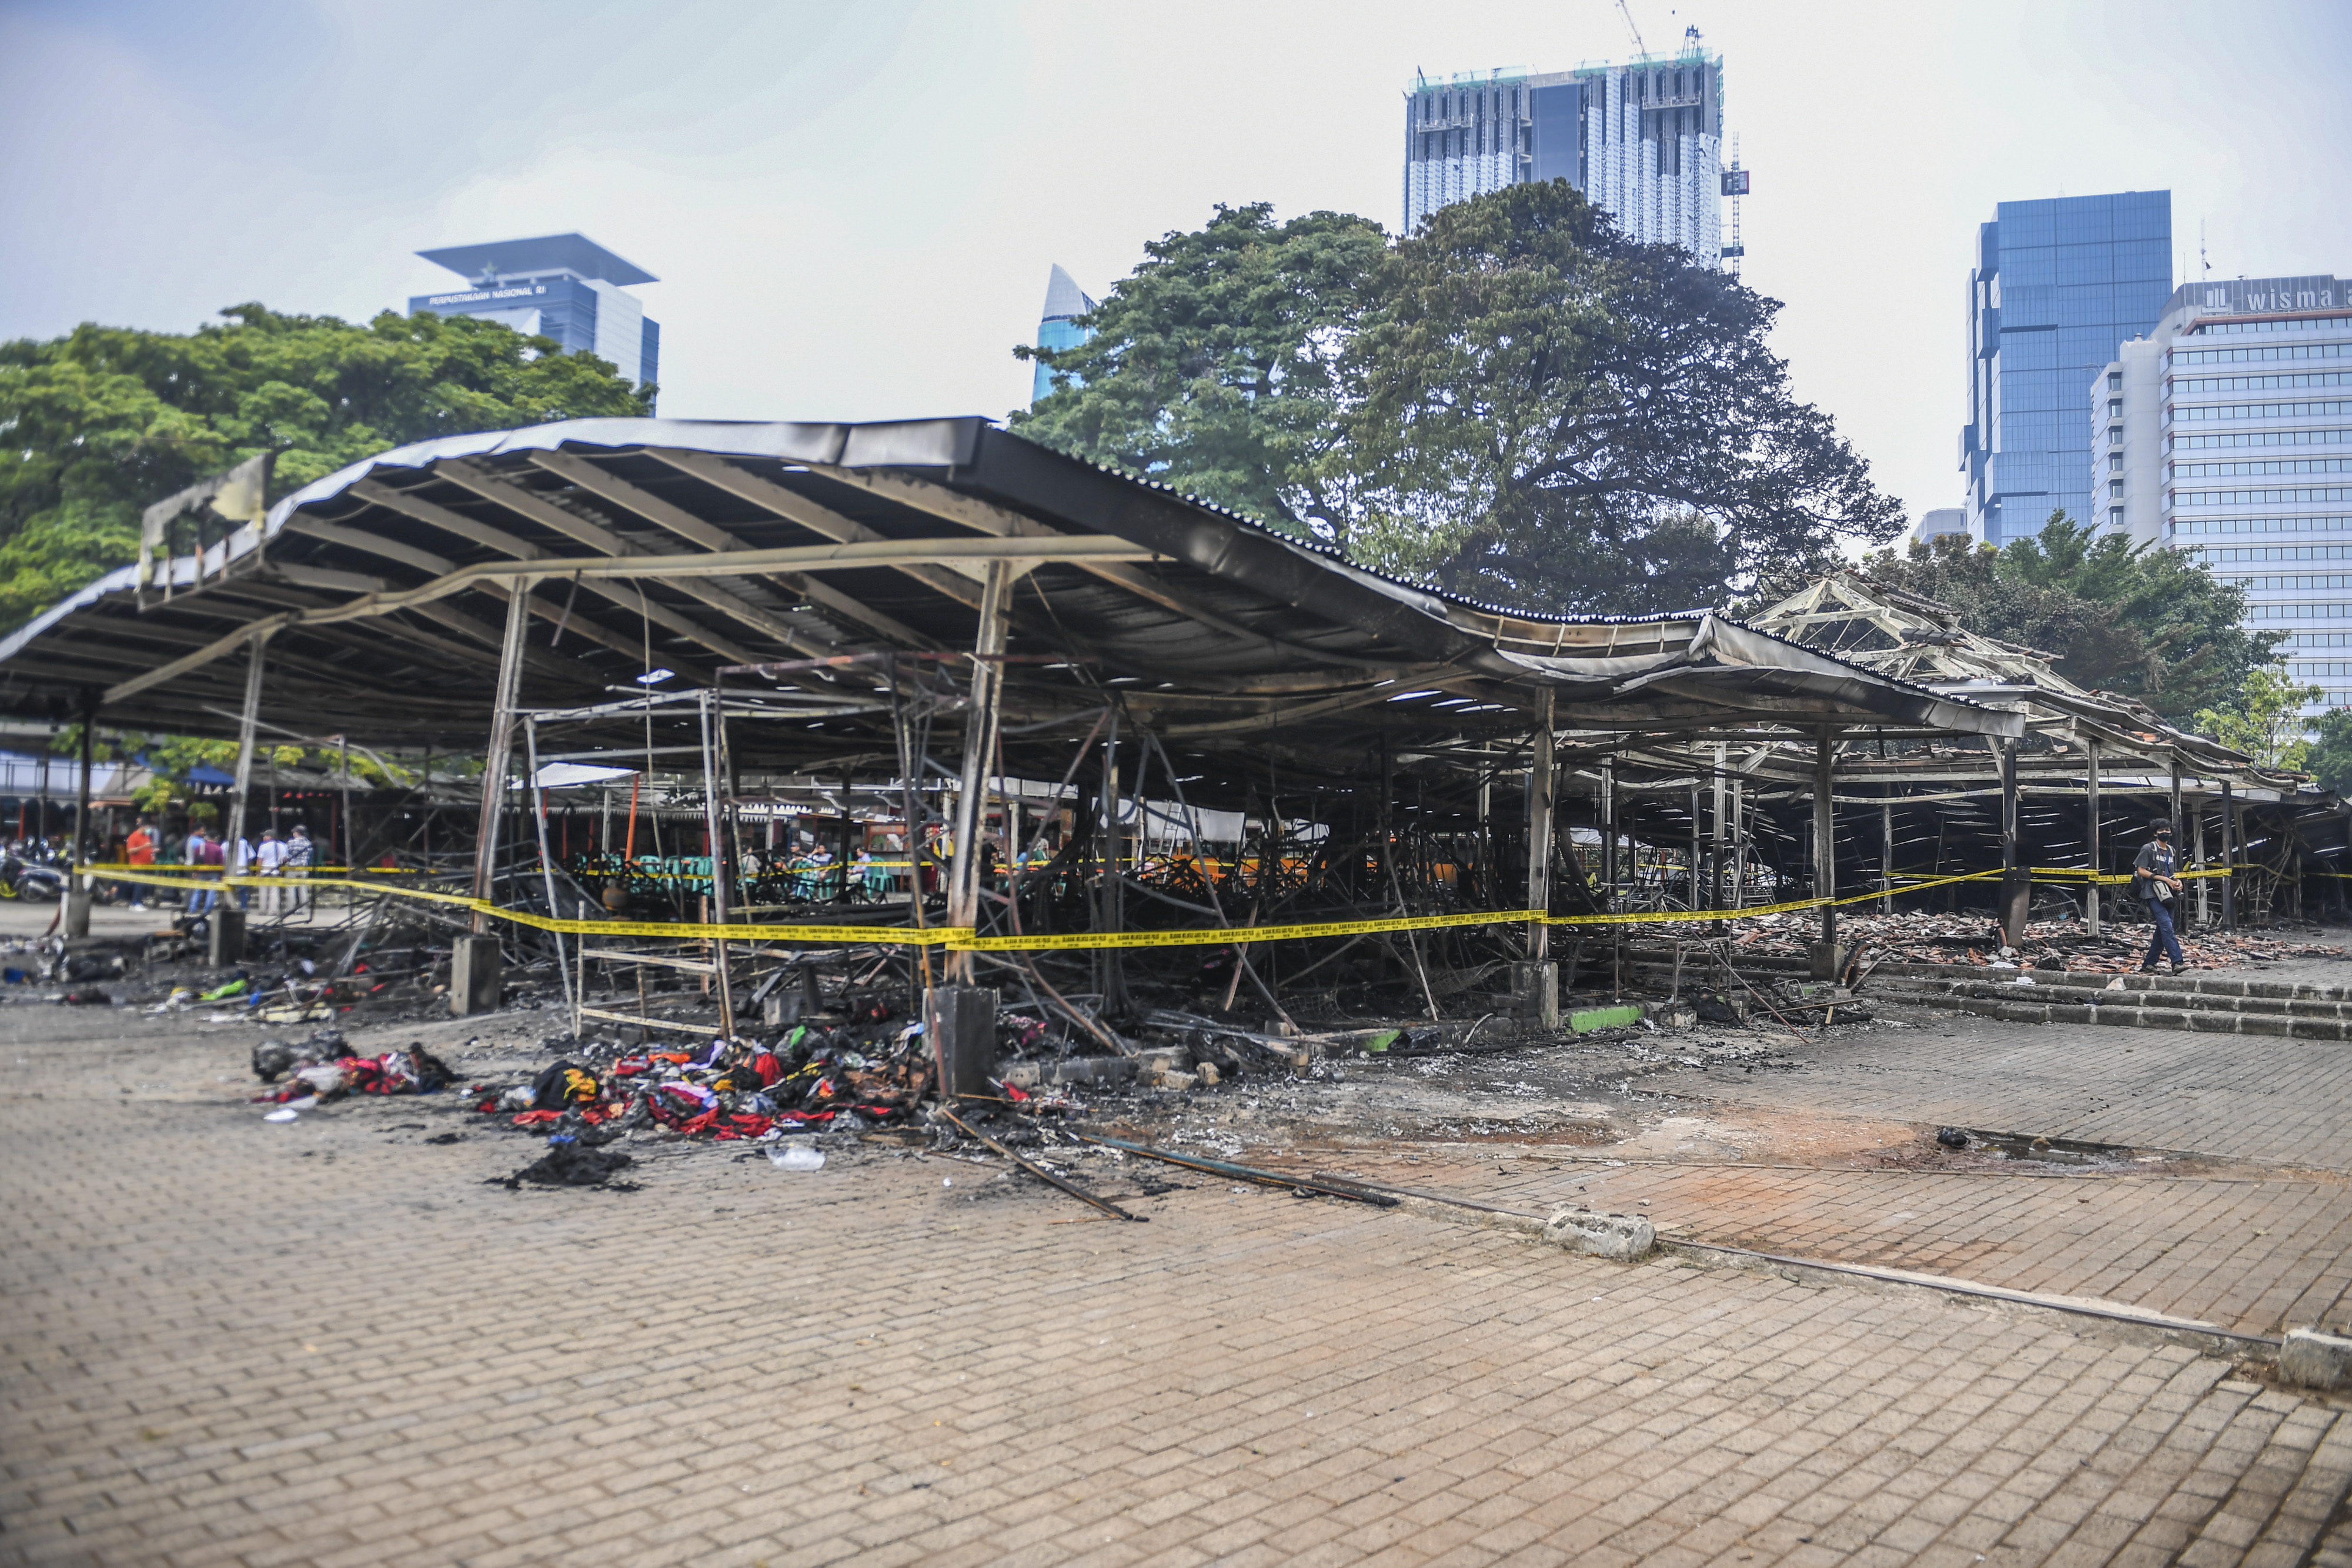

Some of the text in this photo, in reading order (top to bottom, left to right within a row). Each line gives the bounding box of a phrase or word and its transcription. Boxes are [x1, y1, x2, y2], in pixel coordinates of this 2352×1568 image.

[430, 292, 489, 305] PERPUSTAKAAN
[492, 287, 532, 298] NASIONAL
[2247, 288, 2332, 310] wisma
